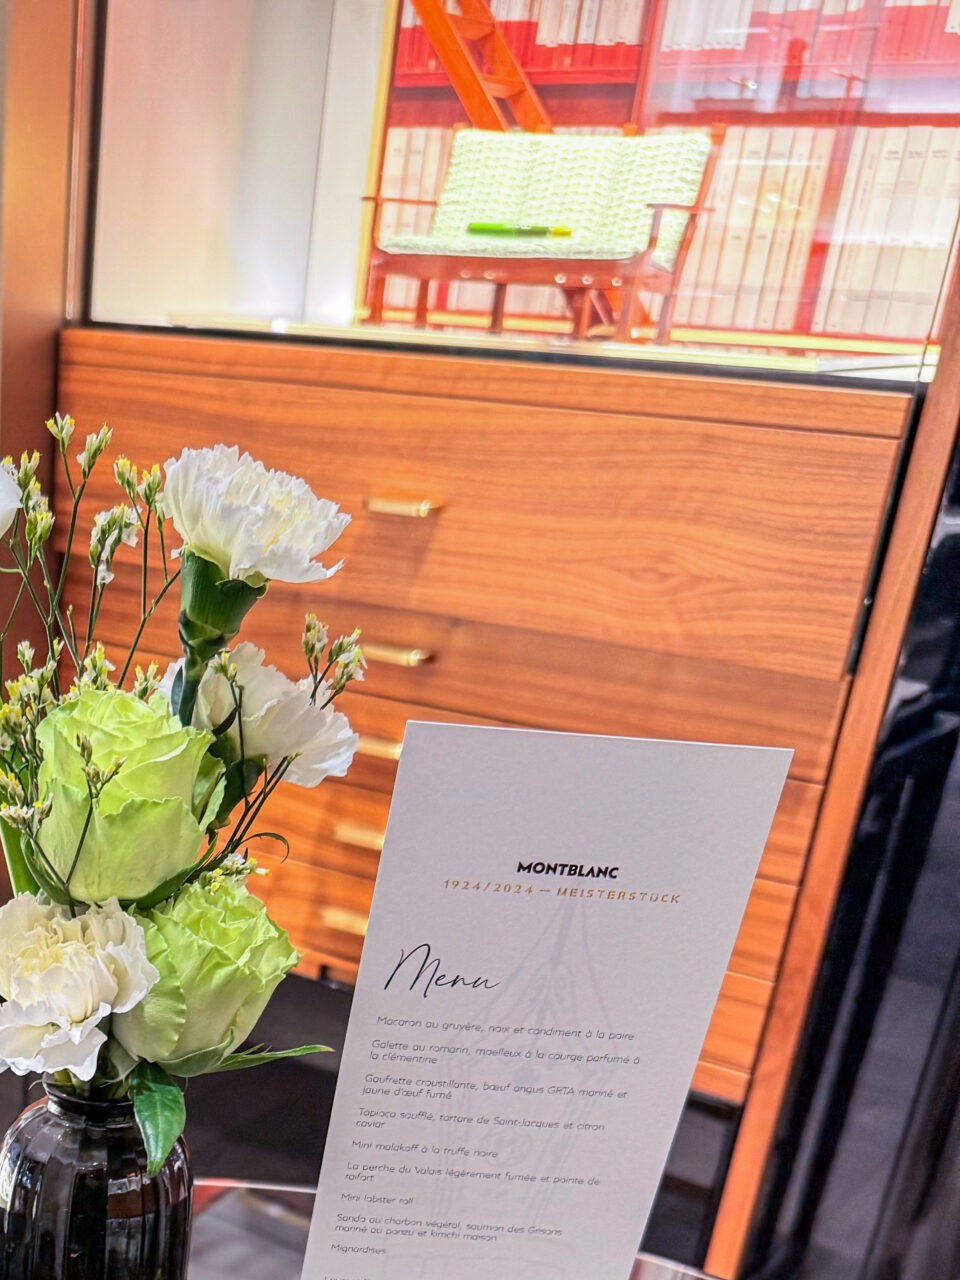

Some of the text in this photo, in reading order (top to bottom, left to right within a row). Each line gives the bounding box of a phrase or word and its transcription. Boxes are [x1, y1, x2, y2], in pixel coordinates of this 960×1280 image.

[516, 861, 619, 879] MONTBLANC
[443, 879, 533, 894] 1924/2024
[556, 887, 680, 904] MEISTERSTÜCK
[383, 943, 500, 999] Menu
[376, 1015, 422, 1027] Macaron
[424, 1021, 439, 1029] au
[441, 1022, 484, 1034] gruyère,
[527, 1026, 582, 1037] condiment
[584, 1029, 593, 1038] à
[595, 1029, 605, 1039] la
[369, 1050, 438, 1064] la clémentine
[371, 1039, 409, 1050] Galette
[411, 1044, 426, 1052] au
[475, 1047, 522, 1058] moelleux
[524, 1050, 532, 1059] à
[535, 1049, 545, 1059] la
[547, 1053, 583, 1062] courge
[585, 1053, 630, 1064] parfumé
[633, 1056, 640, 1065] à
[364, 1073, 413, 1086] Gaufrette
[512, 1085, 544, 1095] angus
[361, 1087, 391, 1096] jaune
[425, 1089, 452, 1100] fumé
[355, 1120, 385, 1128] caviar
[359, 1107, 397, 1118] Tapioca
[439, 1114, 473, 1124] tartare
[476, 1116, 490, 1125] de
[493, 1116, 560, 1128] Saint-Jacques
[563, 1122, 573, 1130] et
[576, 1123, 605, 1131] citron
[351, 1140, 498, 1158] Mini malakoff à la truffe noire
[345, 1172, 374, 1182] raifort
[347, 1161, 359, 1170] La
[362, 1164, 396, 1173] perche
[398, 1164, 411, 1174] du
[414, 1166, 442, 1176] Valais
[445, 1168, 502, 1179] légèrement
[505, 1171, 537, 1182] fumée
[552, 1176, 584, 1185] pointe
[587, 1177, 600, 1186] de
[340, 1193, 414, 1205] Mini lobster roll
[384, 1216, 422, 1226] charbon
[466, 1223, 504, 1232] saumon
[506, 1225, 525, 1233] des
[430, 1229, 460, 1239] kimchi
[463, 1234, 497, 1242] maison
